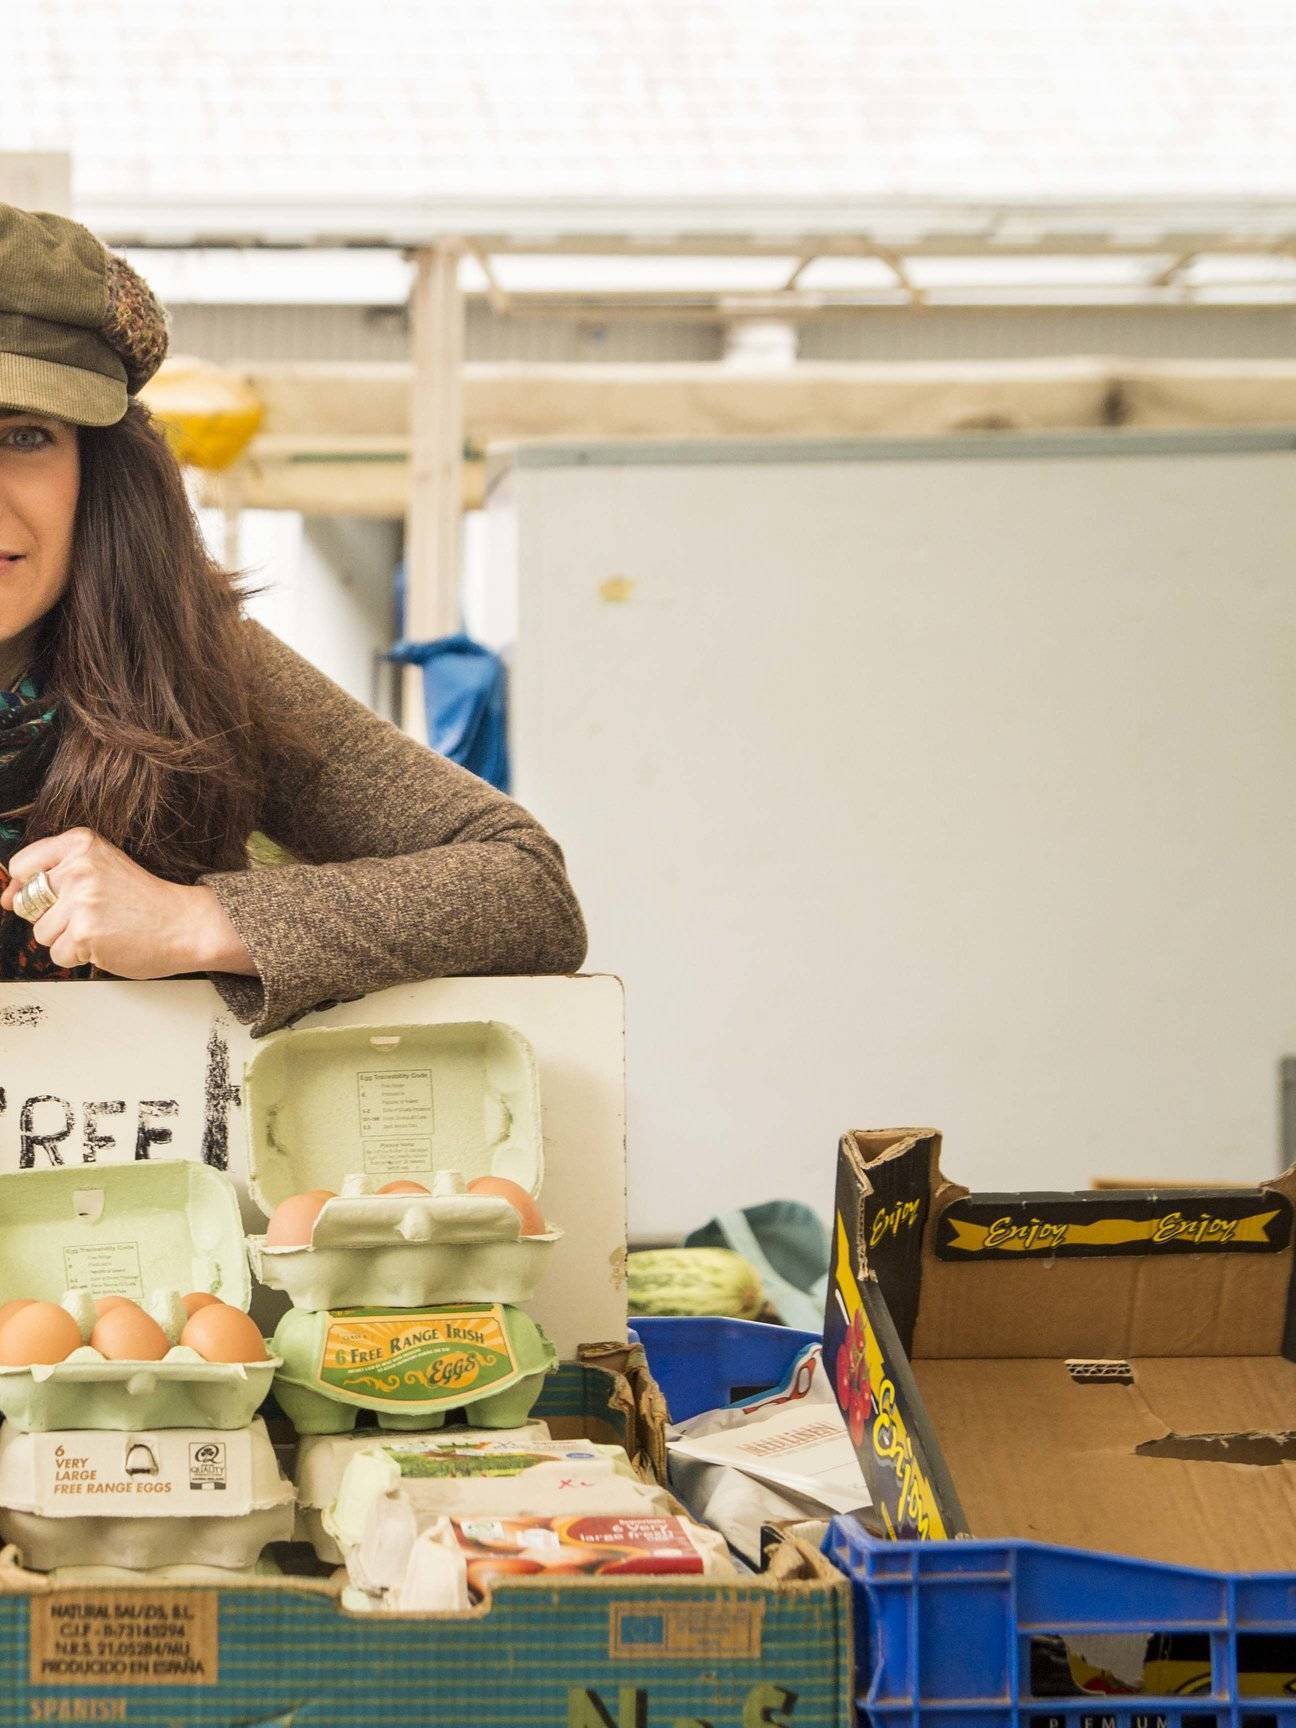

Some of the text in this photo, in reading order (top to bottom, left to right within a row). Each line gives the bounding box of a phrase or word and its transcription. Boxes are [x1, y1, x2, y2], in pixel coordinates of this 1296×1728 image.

[870, 1199, 920, 1246] Enjoy
[984, 1212, 1237, 1249] Enjoy Enjoy
[335, 1349, 346, 1365] 6
[55, 1445, 65, 1457] 6
[55, 1458, 88, 1469] VERY
[55, 1470, 97, 1481] LARGE
[54, 1482, 172, 1494] FREE RANGE EGGS
[51, 1604, 109, 1619] NATURAL
[42, 1660, 126, 1675] PRODUCIDO
[130, 1660, 149, 1675] EN
